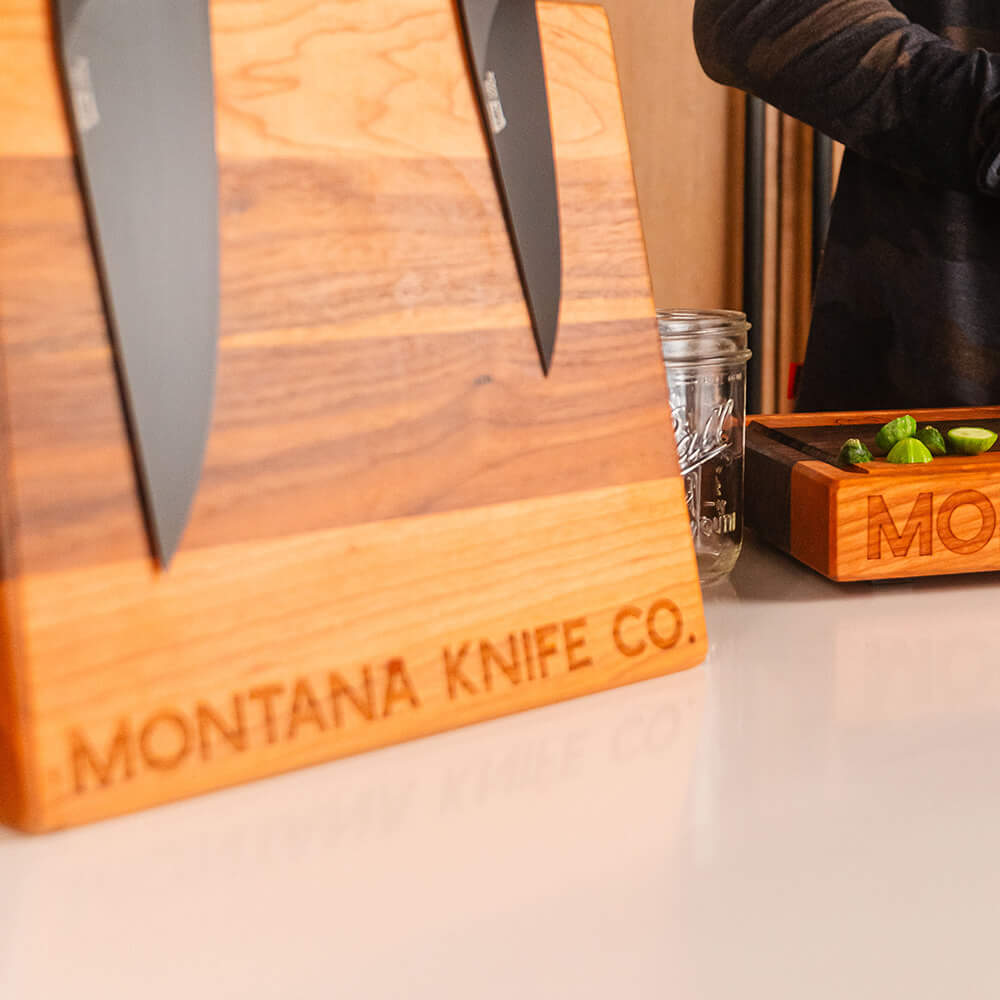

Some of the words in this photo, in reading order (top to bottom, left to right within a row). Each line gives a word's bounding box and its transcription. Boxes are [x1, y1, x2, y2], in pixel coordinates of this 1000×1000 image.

[67, 657, 420, 795] MONTANA
[443, 616, 592, 699] KNIFE
[612, 597, 697, 657] CO.
